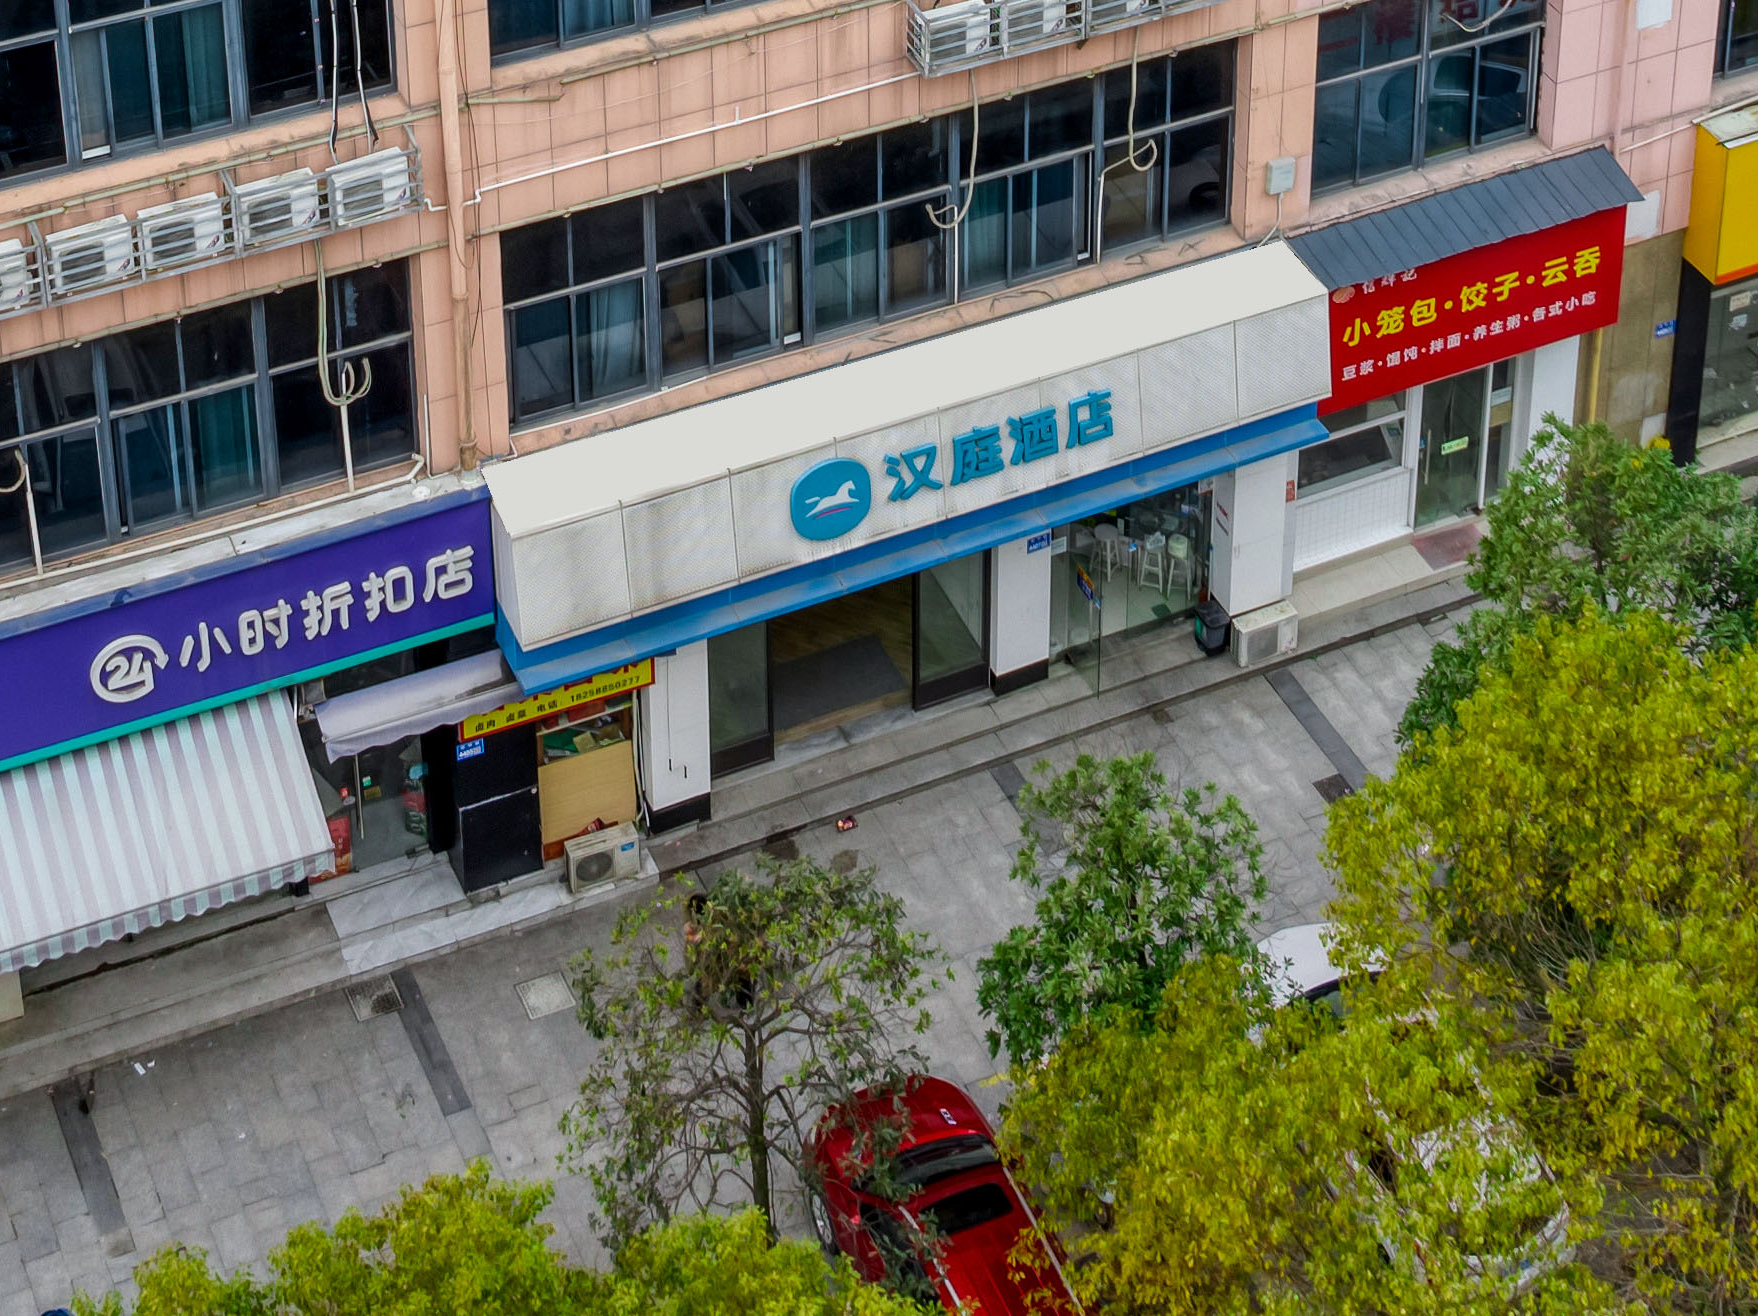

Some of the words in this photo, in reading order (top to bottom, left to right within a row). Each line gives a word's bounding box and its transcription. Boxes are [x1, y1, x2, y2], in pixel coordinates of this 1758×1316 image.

[884, 388, 1114, 503] 汉庭酒店
[178, 544, 475, 672] 小时折扣店
